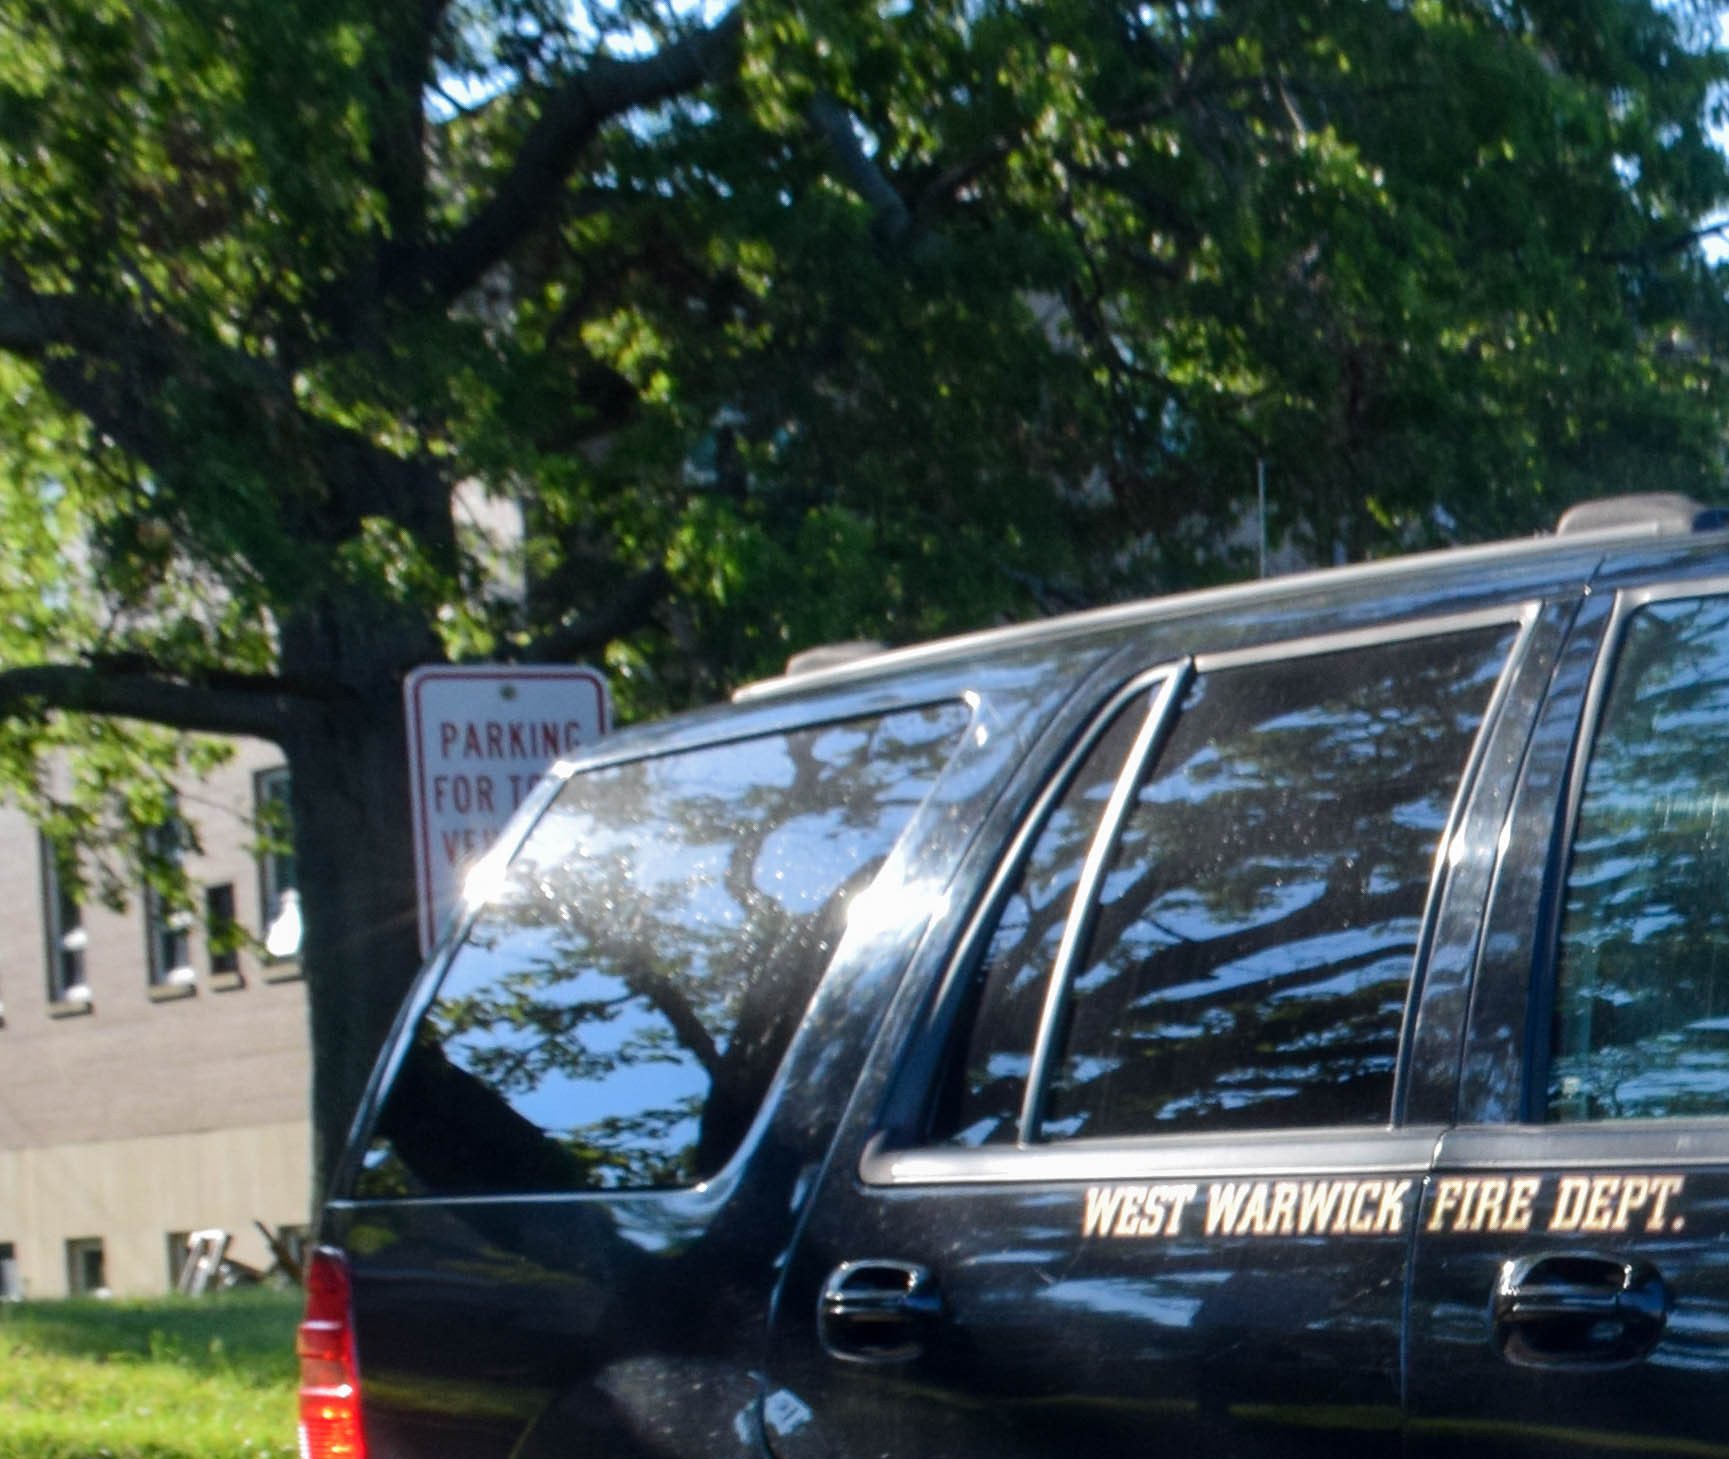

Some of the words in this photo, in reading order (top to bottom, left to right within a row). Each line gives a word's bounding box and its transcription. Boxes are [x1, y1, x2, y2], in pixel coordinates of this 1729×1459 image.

[440, 721, 582, 759] PARKING
[433, 774, 495, 815] FOR
[1082, 1183, 1198, 1238] WEST
[1204, 1178, 1412, 1237] WARWICK
[1426, 1175, 1542, 1233] FIRE
[1547, 1175, 1686, 1233] DEPT.
